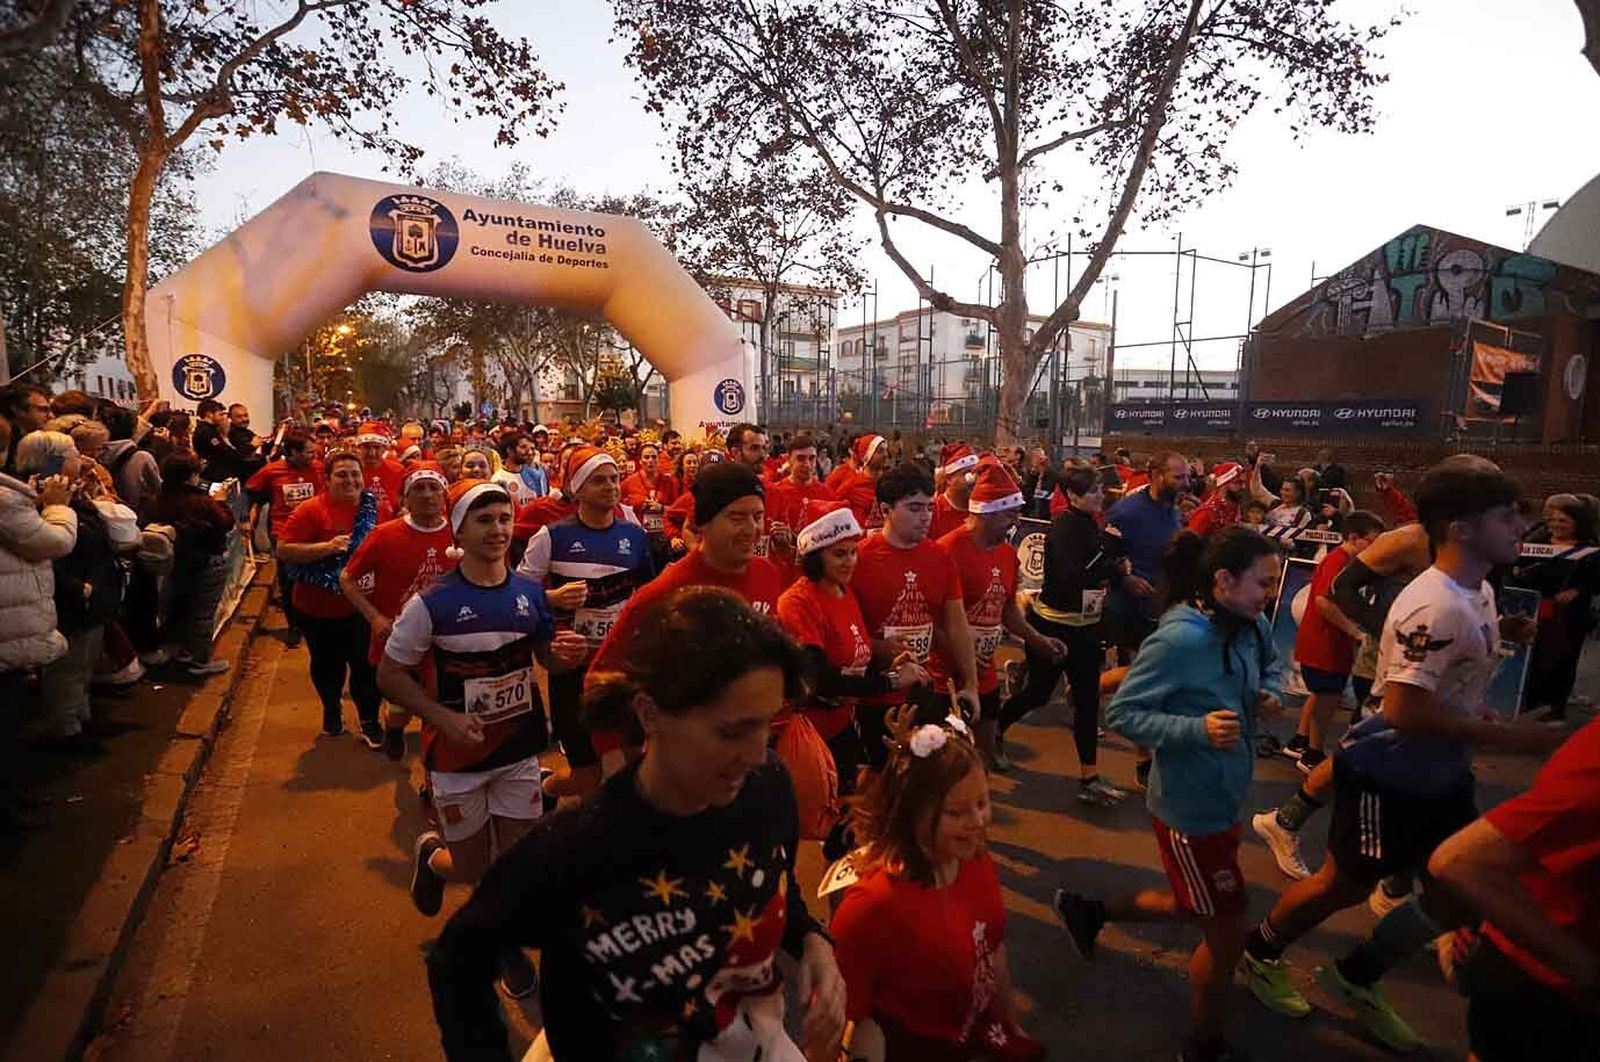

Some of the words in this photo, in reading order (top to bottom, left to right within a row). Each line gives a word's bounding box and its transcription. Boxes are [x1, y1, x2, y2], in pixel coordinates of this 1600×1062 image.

[462, 208, 605, 237] Ayuntamiento
[506, 231, 531, 246] de
[538, 234, 607, 255] Huelva
[539, 253, 554, 264] de
[557, 255, 608, 268] Deportes
[1128, 409, 1165, 418] HYUNDAI
[1189, 409, 1231, 418] HYUNDAI
[1271, 408, 1321, 418] HYUNDAI
[1357, 408, 1416, 418] HYUNDAI
[495, 683, 524, 708] 570
[586, 907, 696, 963] MERRY
[608, 934, 715, 1003] X-MAS
